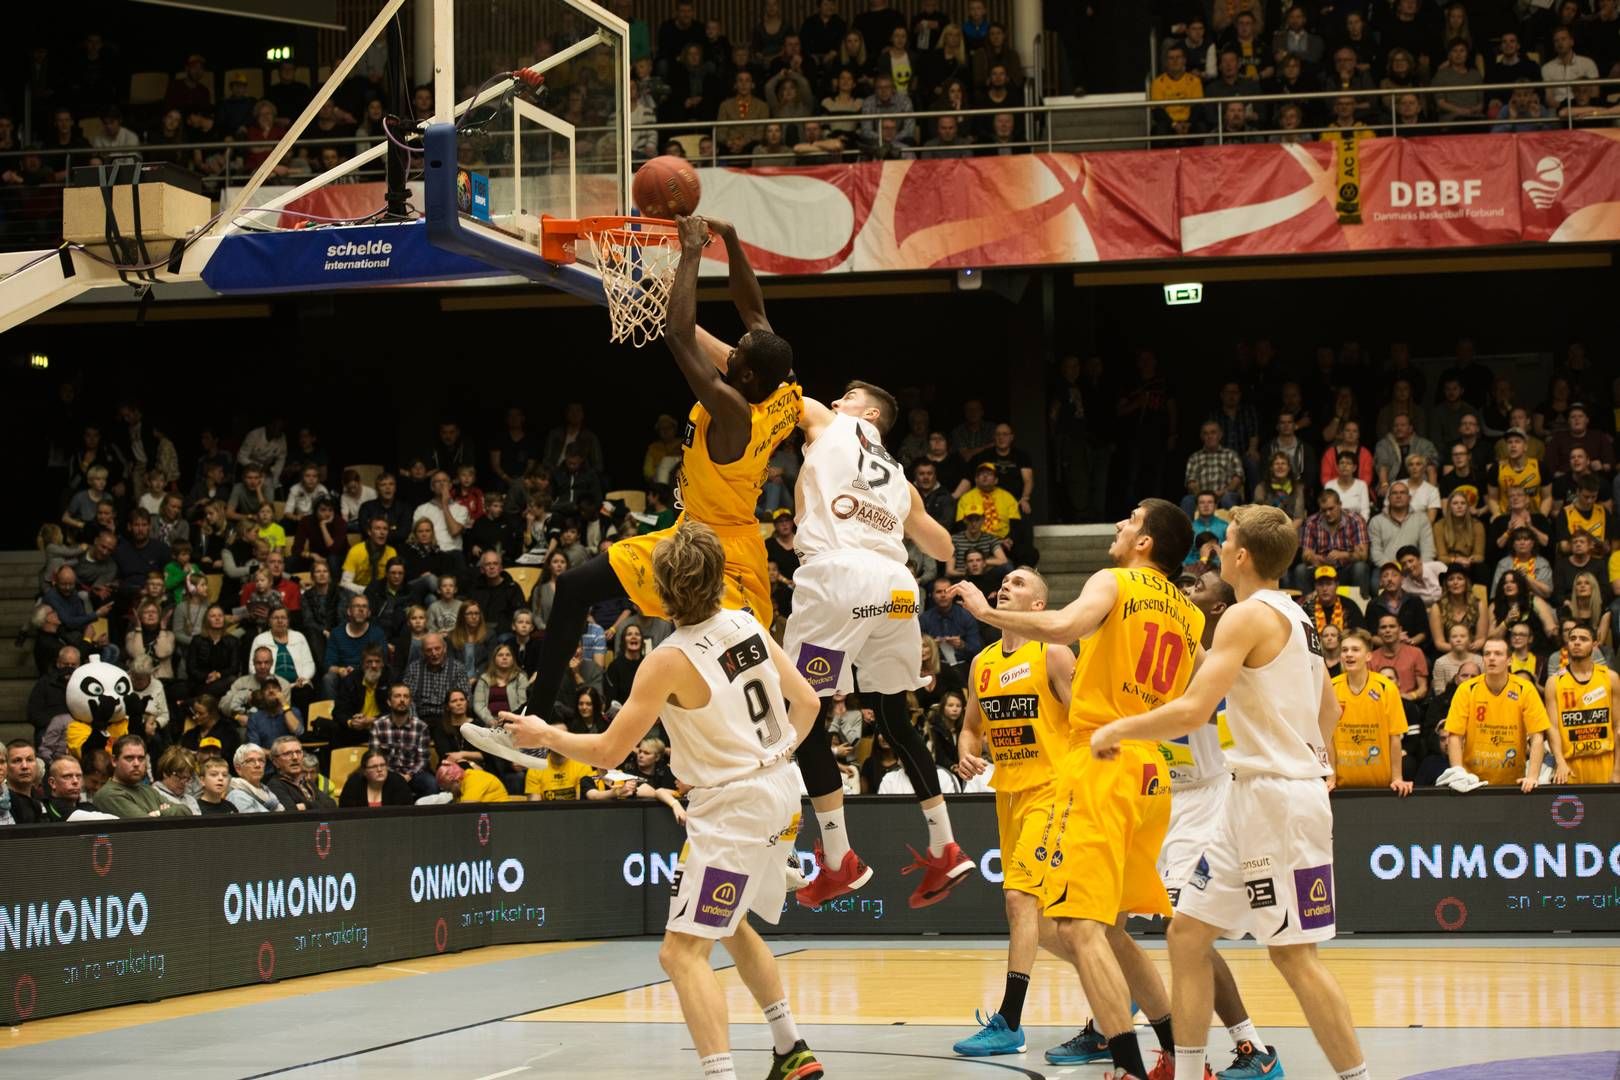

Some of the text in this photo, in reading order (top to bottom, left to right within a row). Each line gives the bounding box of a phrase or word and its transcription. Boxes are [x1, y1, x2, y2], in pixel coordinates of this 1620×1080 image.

[1390, 179, 1482, 207] DBBF
[1373, 207, 1505, 222] Danmarks Basketball Forbund
[327, 239, 393, 257] schelde
[324, 257, 390, 270] international
[857, 506, 897, 531] AARHUS
[852, 600, 920, 620] Stiftsidende
[1134, 621, 1184, 695] 10
[980, 668, 991, 692] 9
[1010, 697, 1036, 711] ART
[1562, 691, 1576, 710] 11
[743, 678, 782, 749] 9
[1476, 705, 1486, 722] 8
[1562, 712, 1582, 722] PRO
[1592, 709, 1608, 719] ART
[223, 872, 356, 925] ONMONDO
